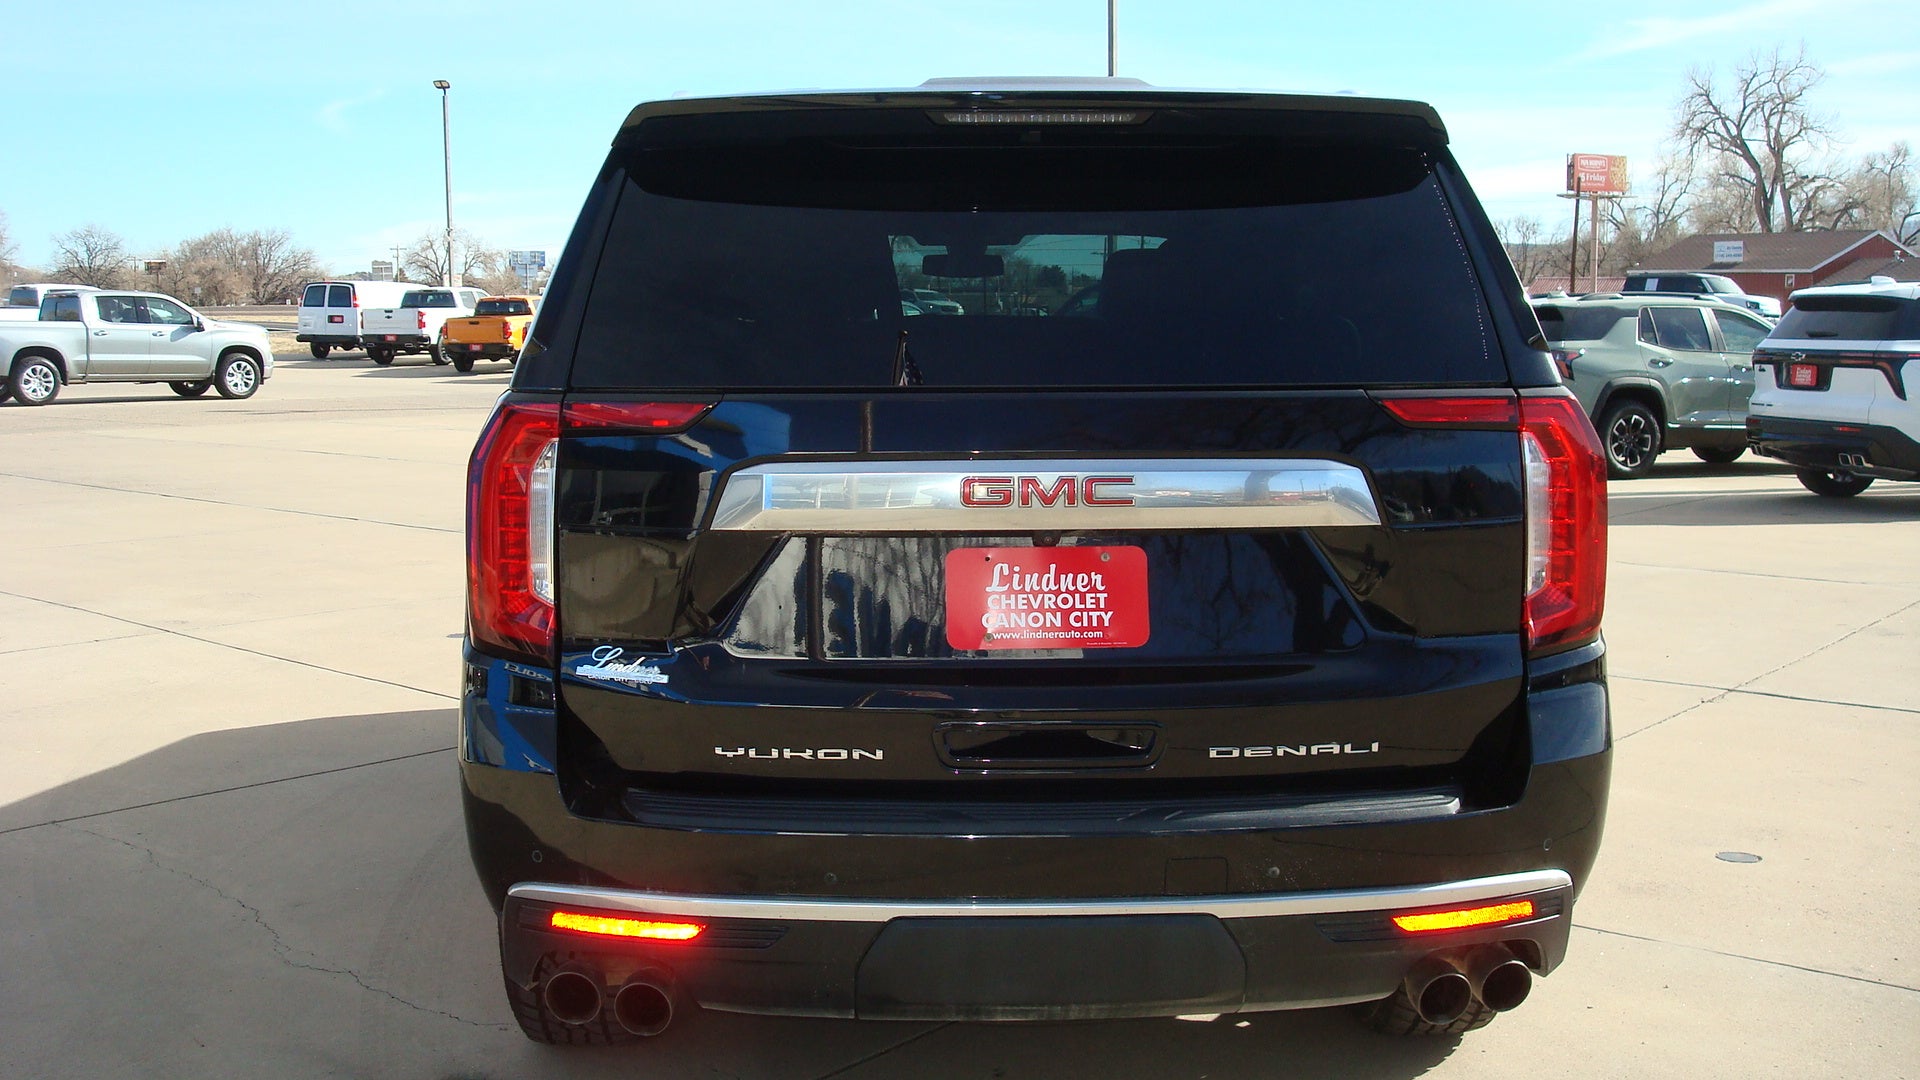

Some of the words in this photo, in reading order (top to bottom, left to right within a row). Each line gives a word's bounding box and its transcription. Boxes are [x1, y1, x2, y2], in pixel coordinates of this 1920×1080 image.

[960, 475, 1136, 508] GMC
[985, 562, 1106, 592] Lindner
[987, 592, 1108, 610] CHEVROLET
[981, 611, 1062, 629] CANON
[1069, 610, 1114, 628] CITY
[993, 629, 1103, 640] www.lindnerauto.com
[714, 746, 883, 761] YUKON
[1209, 741, 1379, 759] DENALI
